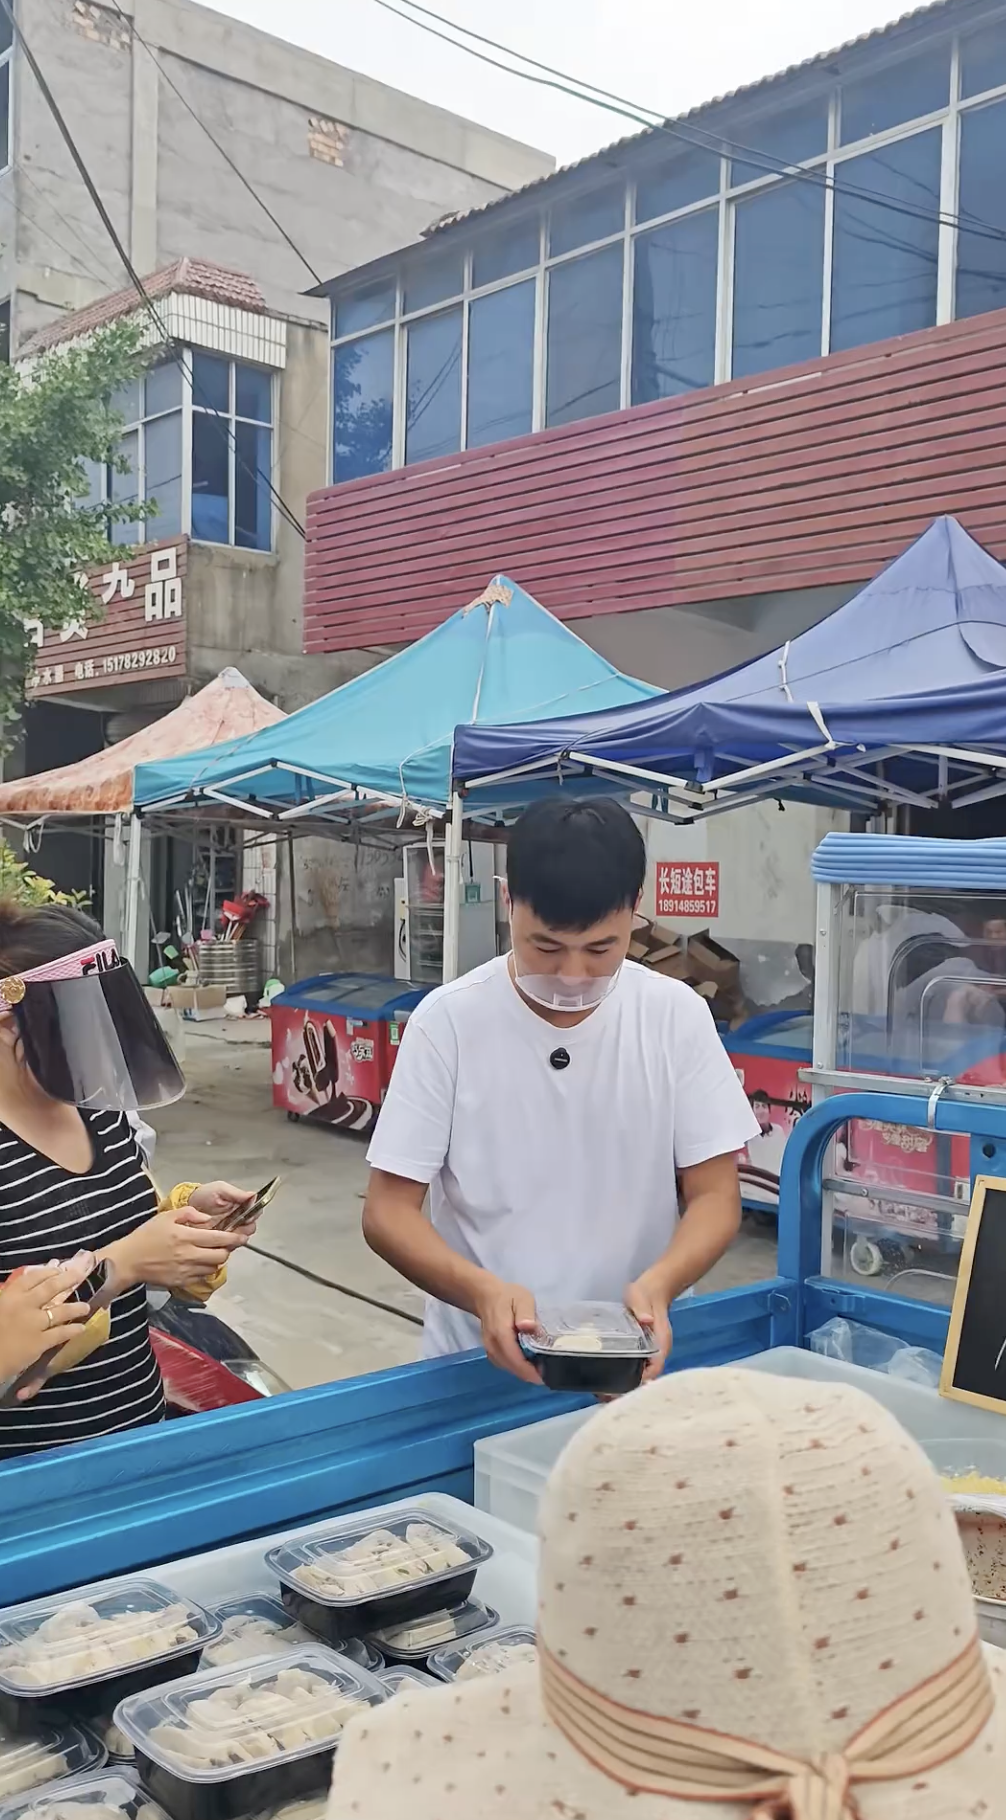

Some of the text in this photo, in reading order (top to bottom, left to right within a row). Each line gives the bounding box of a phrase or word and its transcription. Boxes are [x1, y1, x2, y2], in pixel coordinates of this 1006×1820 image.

[103, 646, 176, 674] 15178292820
[659, 867, 716, 896] 长短途包车
[658, 899, 716, 913] 18914859517
[80, 948, 120, 976] FILA
